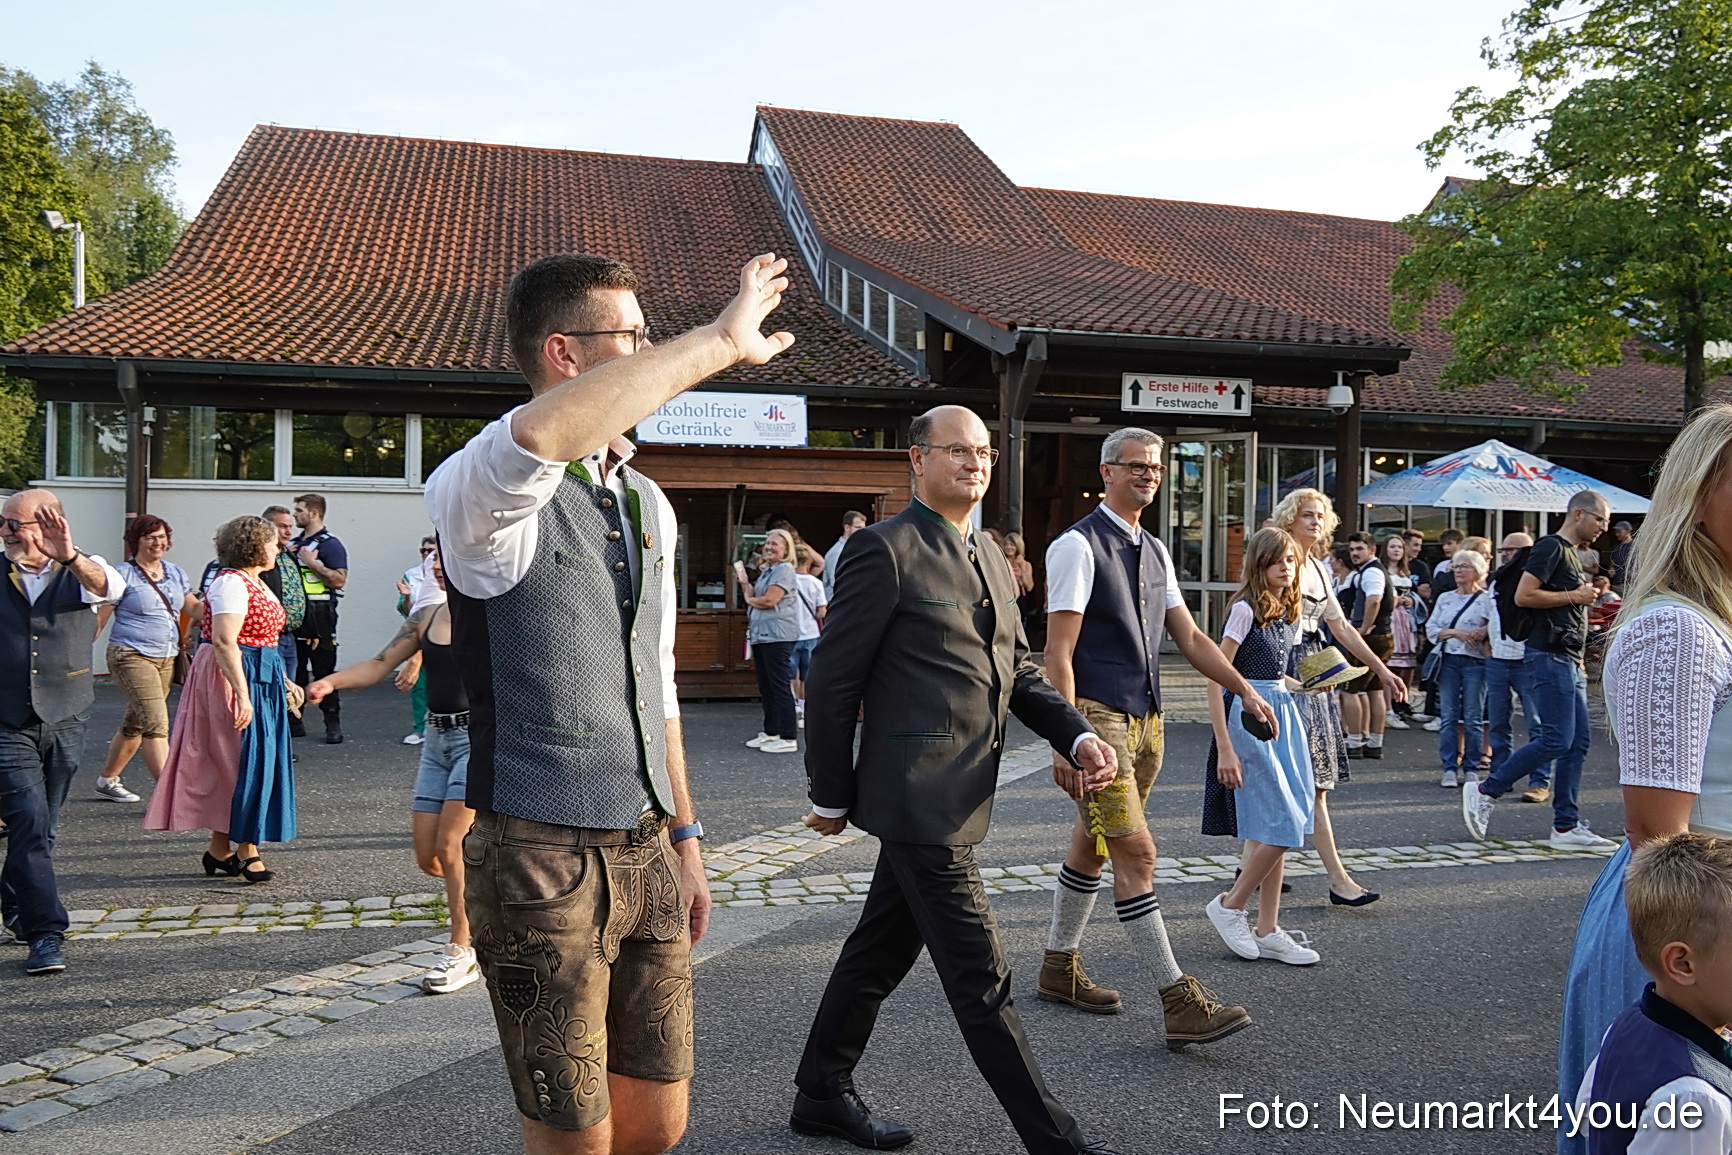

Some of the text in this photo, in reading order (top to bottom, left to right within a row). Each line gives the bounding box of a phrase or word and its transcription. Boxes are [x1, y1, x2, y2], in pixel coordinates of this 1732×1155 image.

[1148, 380, 1209, 394] Erste Hilfe
[653, 402, 748, 419] lkoholfreie
[1155, 396, 1219, 410] Festwache
[656, 420, 733, 437] Getränke
